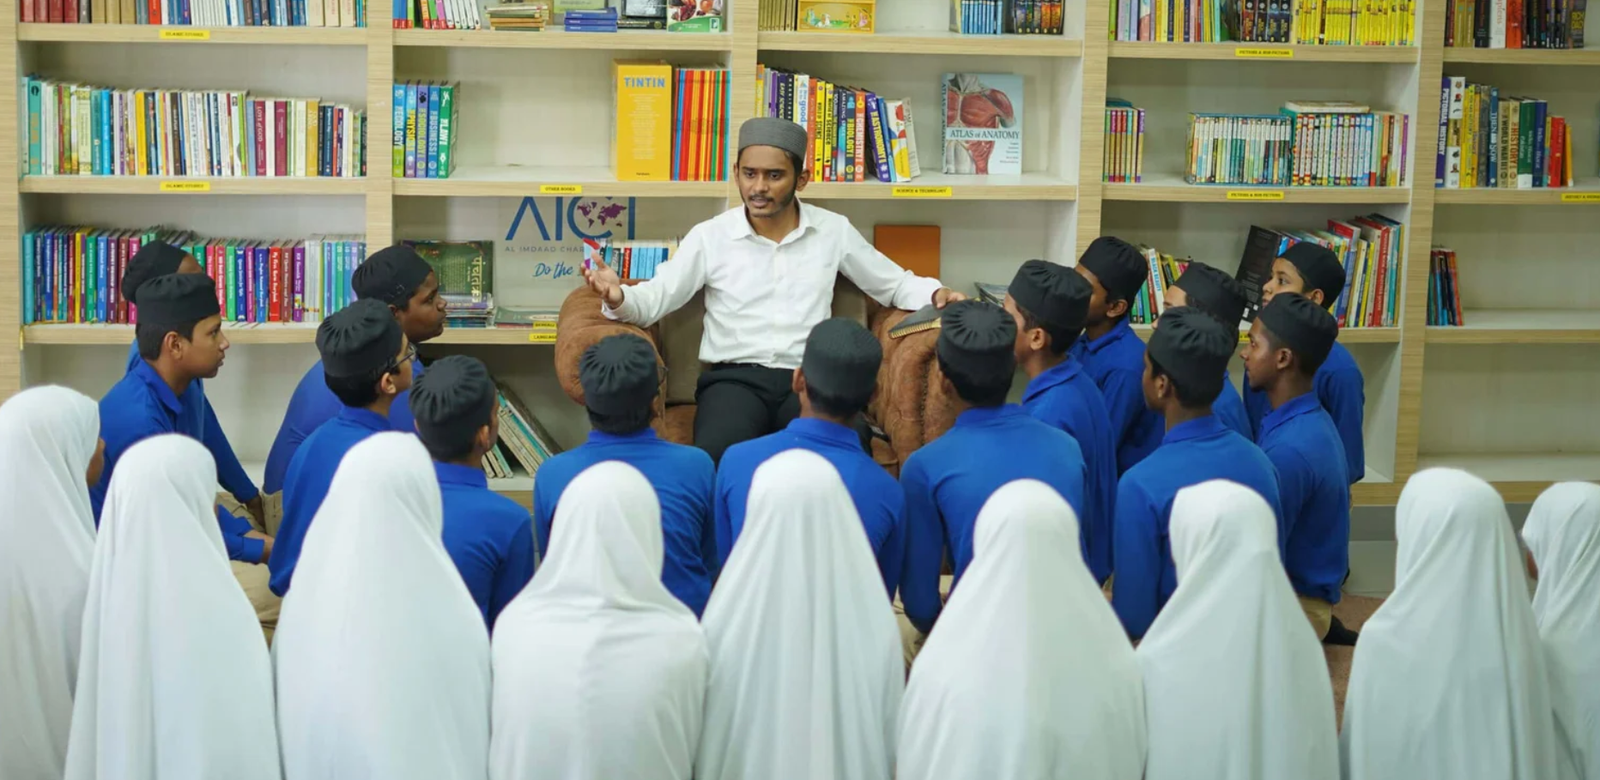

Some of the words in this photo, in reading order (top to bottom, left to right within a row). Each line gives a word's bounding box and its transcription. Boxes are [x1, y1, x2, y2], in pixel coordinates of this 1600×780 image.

[1495, 0, 1505, 25] apiens
[623, 76, 666, 88] TINTIN
[798, 100, 808, 123] good
[1440, 88, 1450, 124] PICTORIAL
[394, 110, 403, 145] ECOLOGY
[417, 112, 427, 154] SOCIOLOGY
[428, 115, 438, 152] BUSINESS
[439, 124, 449, 143] LAW
[846, 123, 855, 153] BIOLOGY
[855, 118, 864, 158] CHEMISTRY
[869, 116, 886, 159] ASTRONOMY
[950, 130, 974, 138] ATLAS
[975, 130, 981, 138] of
[981, 130, 1020, 139] ANATOMY
[1438, 125, 1447, 156] HISTORY
[1500, 145, 1508, 161] WAR
[1510, 127, 1518, 164] HISTORY
[532, 262, 552, 277] Do
[553, 261, 574, 279] the
